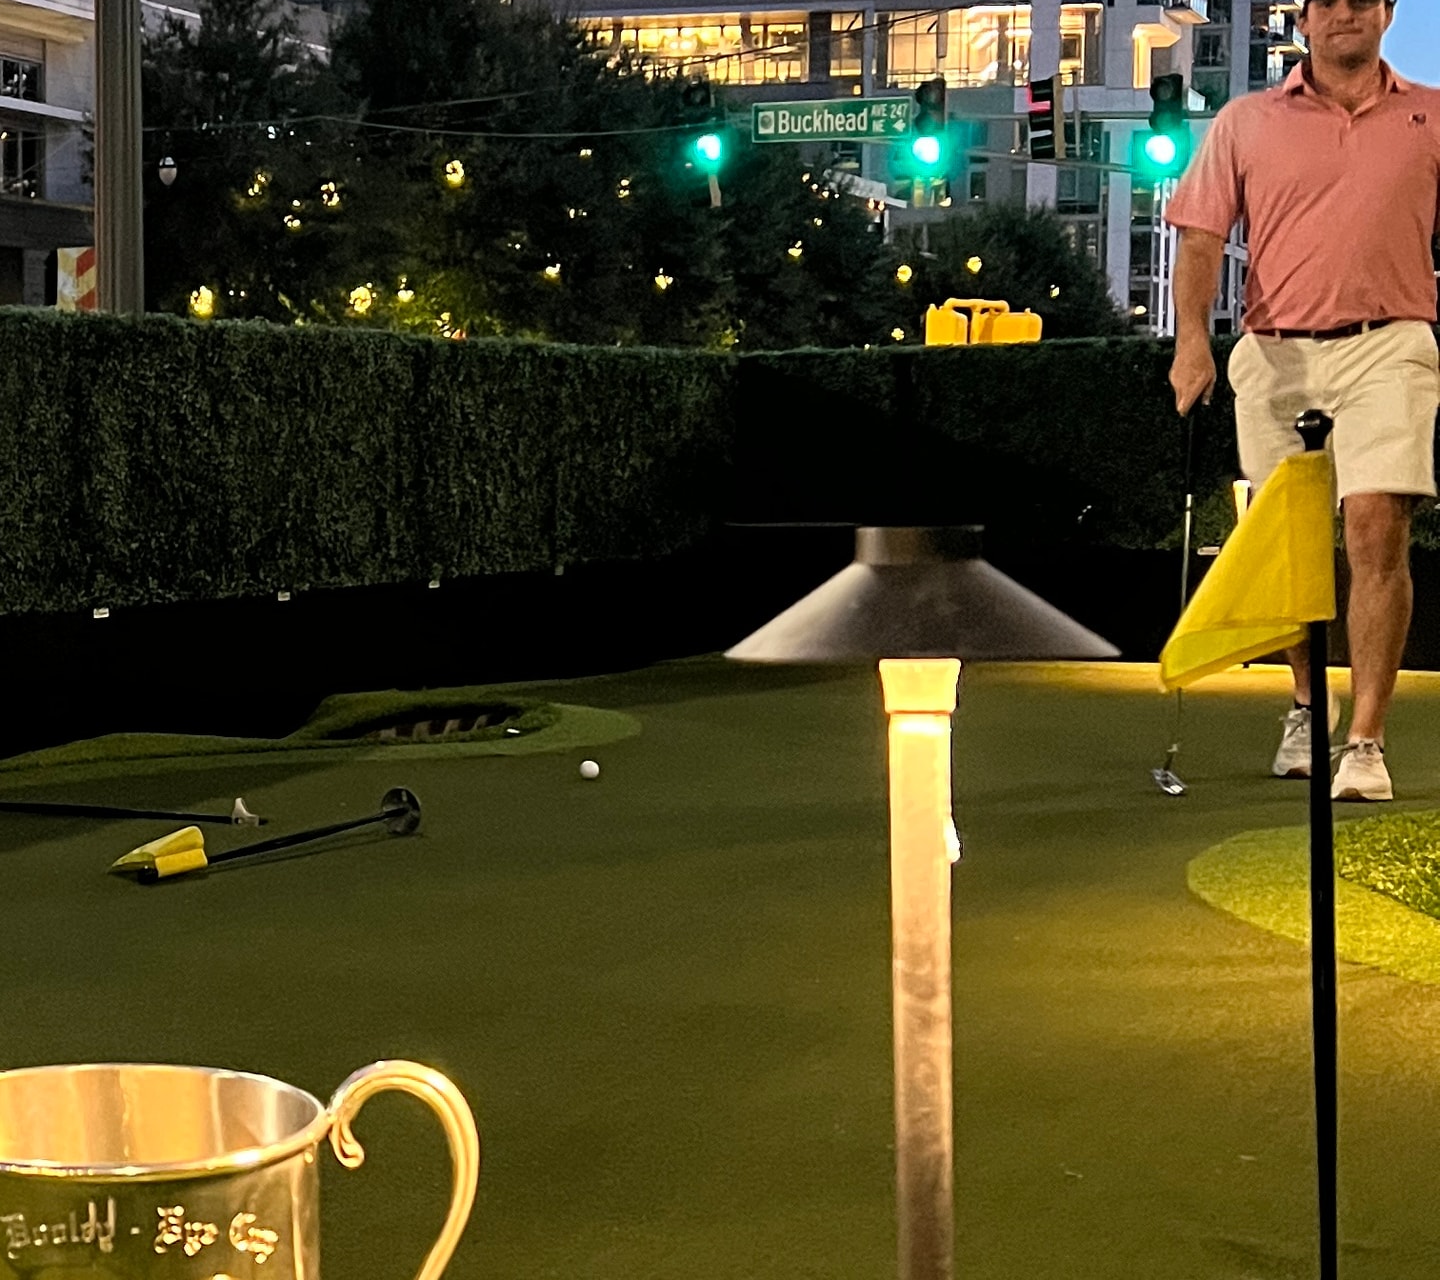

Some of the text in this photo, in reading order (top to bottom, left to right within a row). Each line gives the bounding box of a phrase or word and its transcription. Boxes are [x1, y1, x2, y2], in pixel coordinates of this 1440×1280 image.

[870, 103, 909, 120] AVE 247
[778, 107, 869, 134] Buckhead
[872, 120, 885, 133] NE
